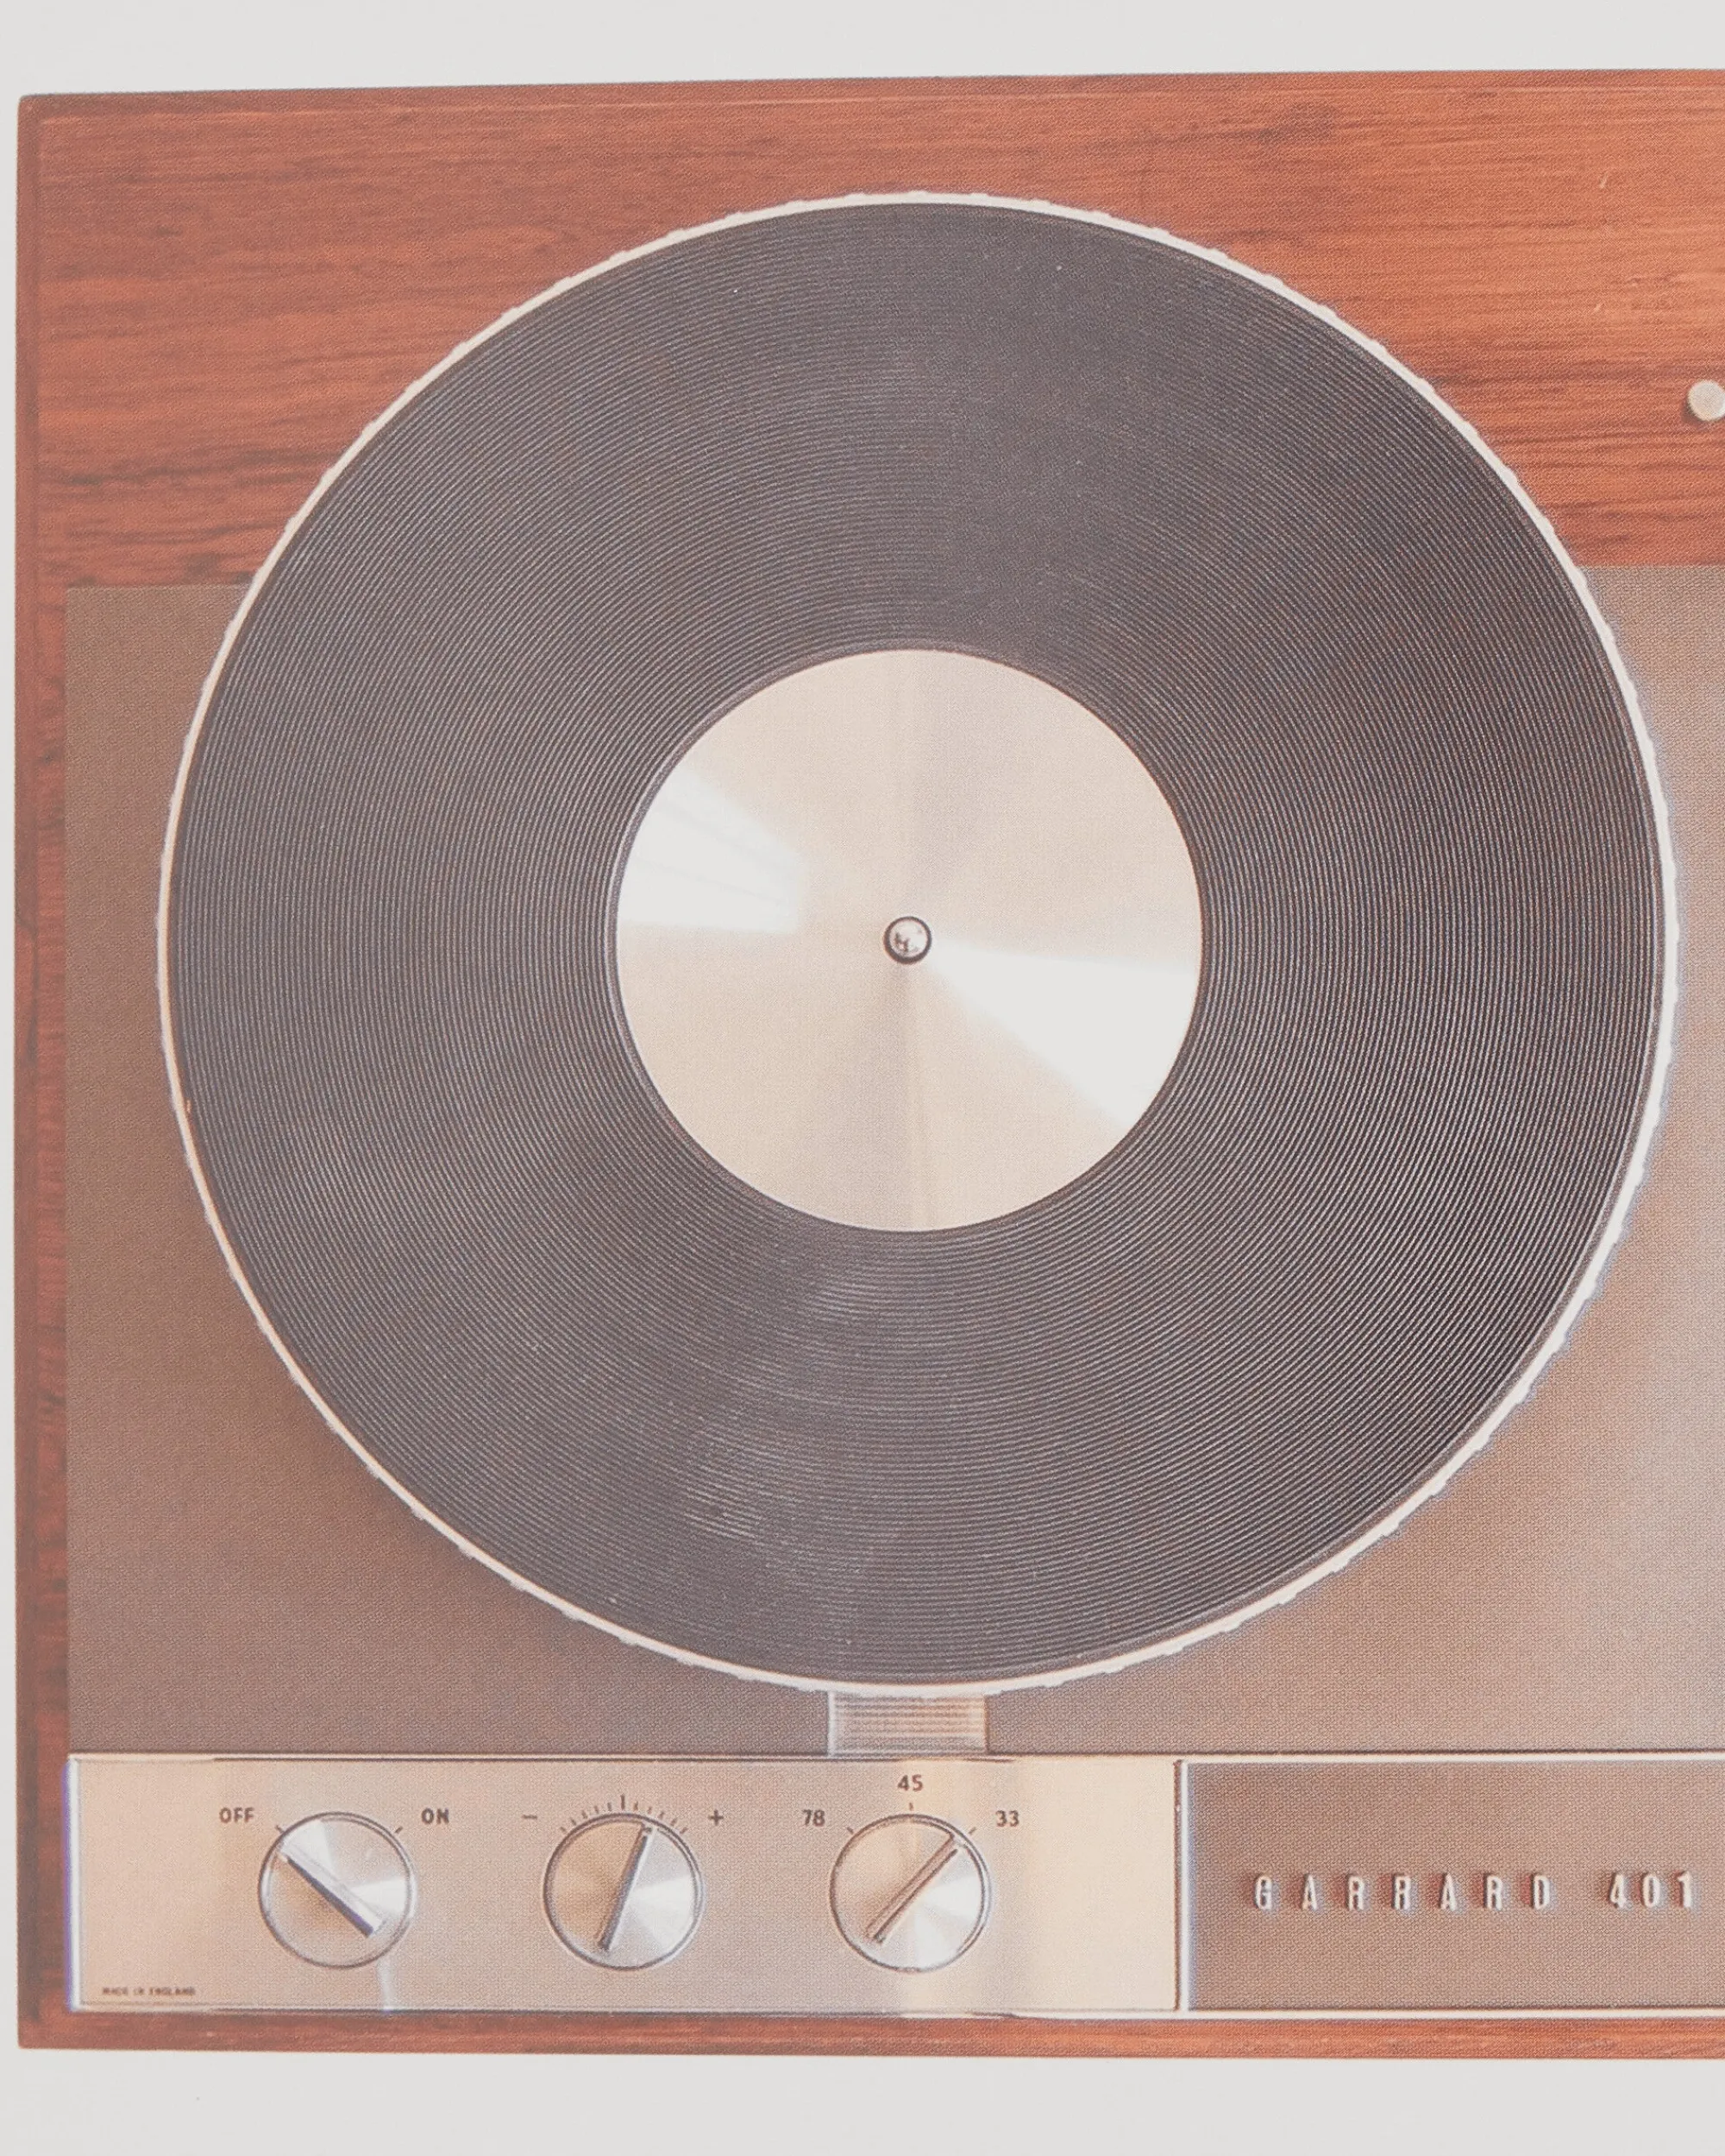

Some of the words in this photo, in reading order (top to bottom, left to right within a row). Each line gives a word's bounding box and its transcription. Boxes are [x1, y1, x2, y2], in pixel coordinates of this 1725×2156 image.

[897, 1774, 924, 1792] 45
[218, 1807, 255, 1825] OFF
[420, 1808, 450, 1826] ON
[801, 1809, 826, 1827] 78
[995, 1810, 1020, 1827] 33
[1254, 1874, 1552, 1912] GARRARD
[1609, 1871, 1694, 1909] 401
